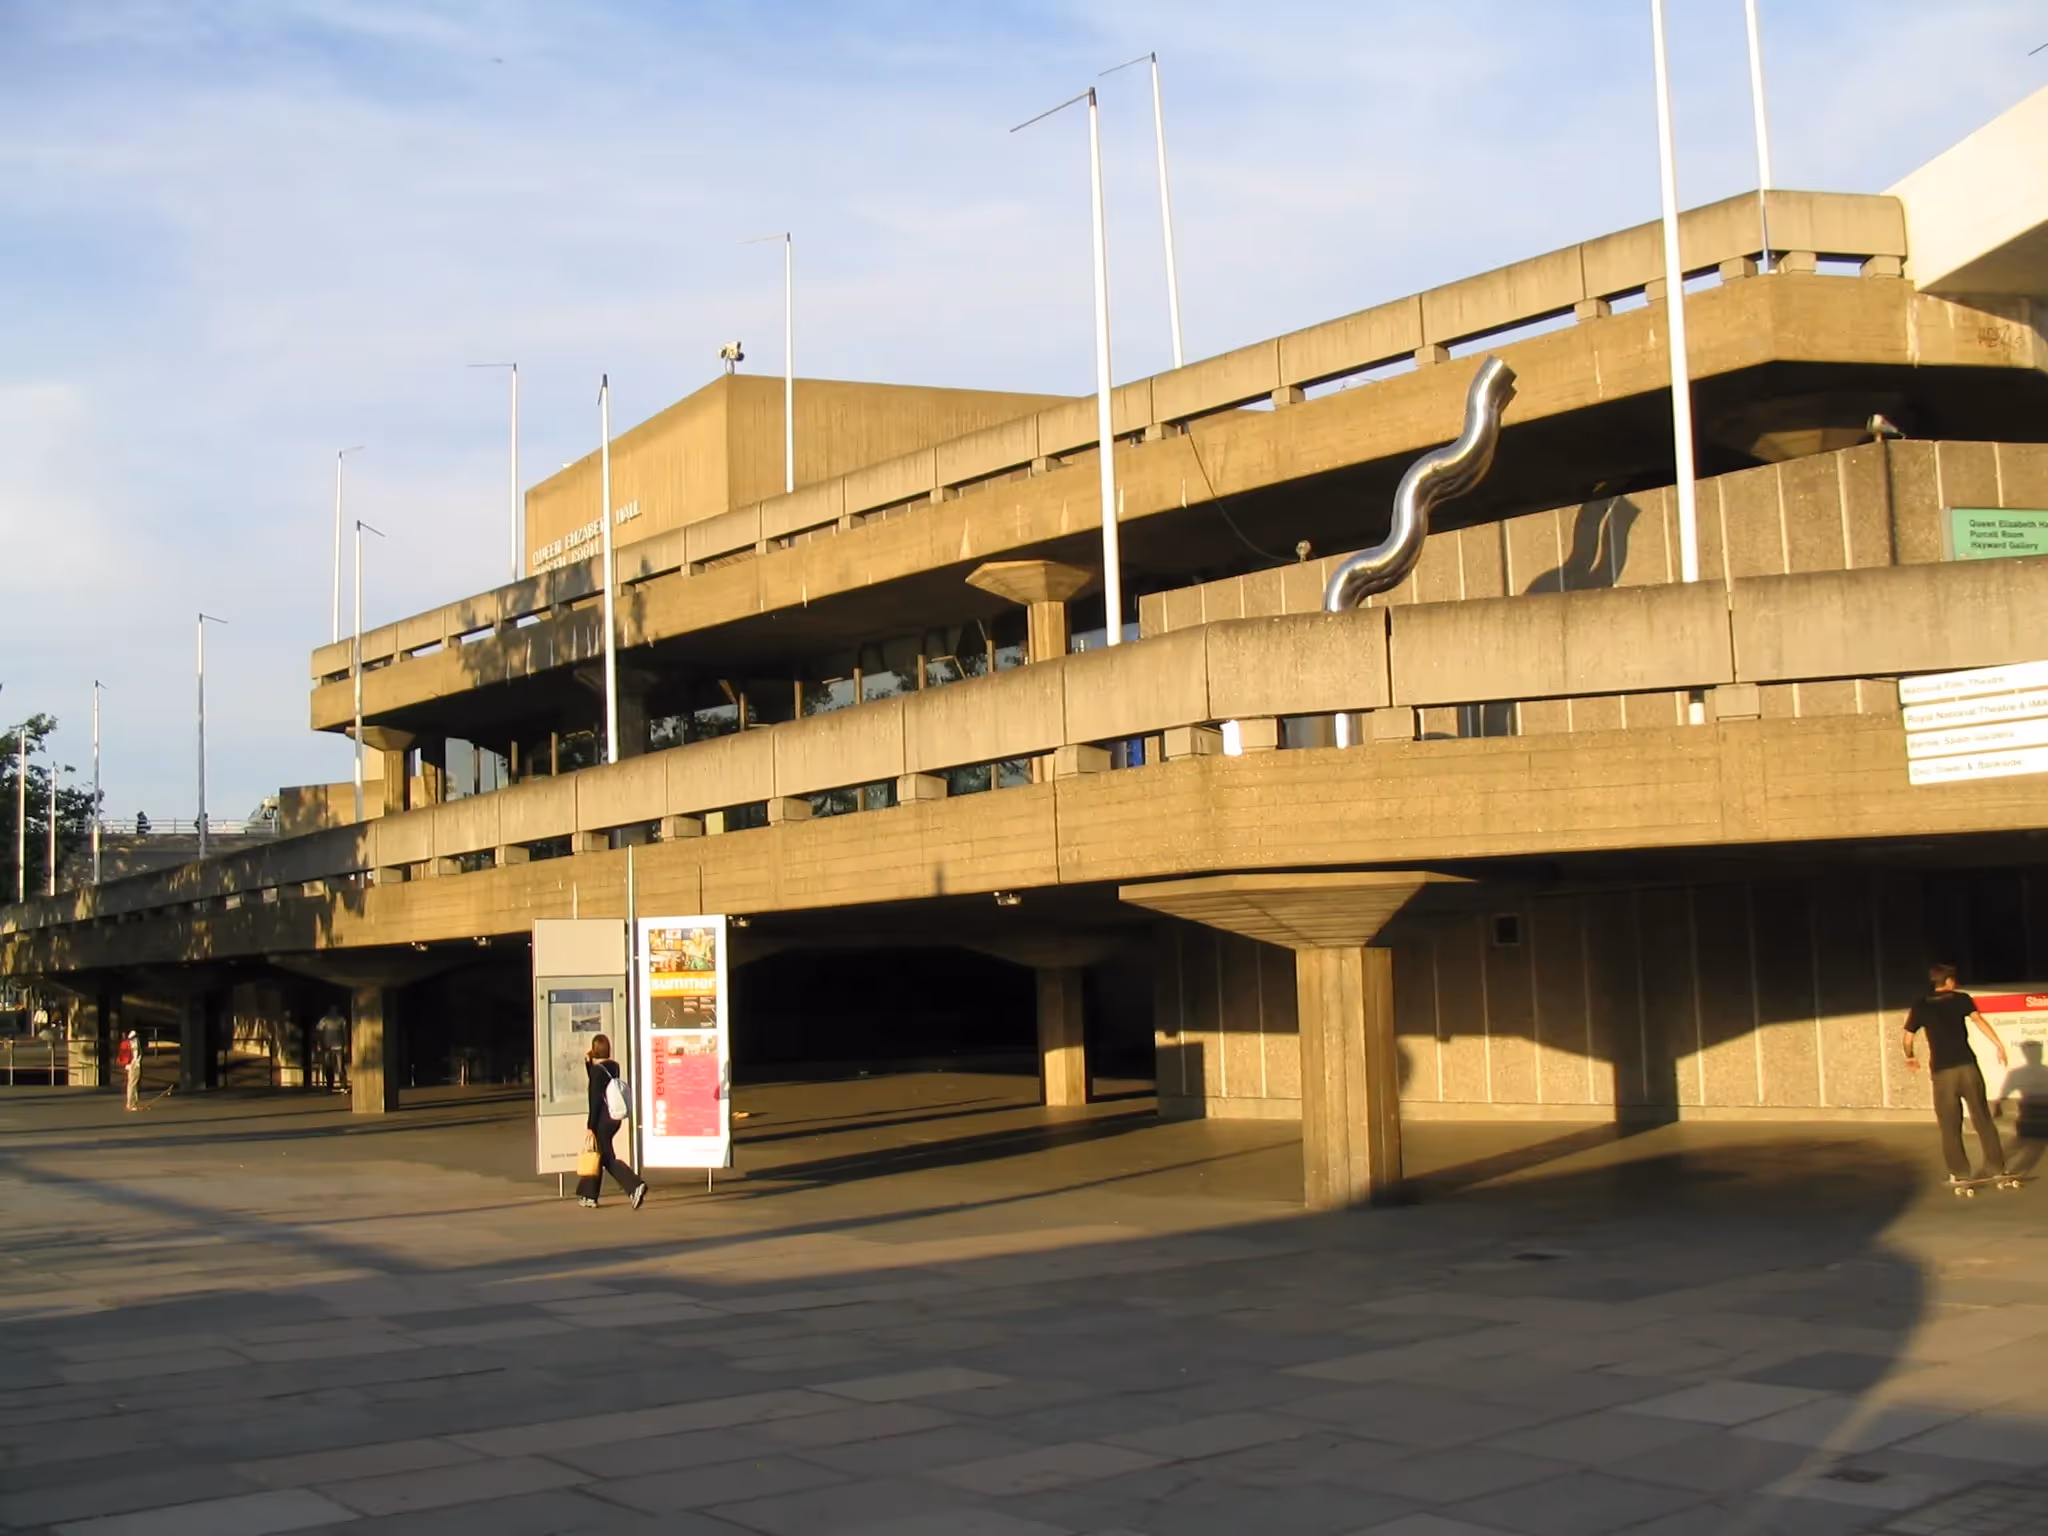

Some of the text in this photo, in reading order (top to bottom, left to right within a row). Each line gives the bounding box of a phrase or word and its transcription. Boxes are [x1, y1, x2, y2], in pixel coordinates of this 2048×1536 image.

[1969, 519, 1996, 528] Queen
[1999, 519, 2037, 528] Elizabeth
[532, 499, 641, 566] QUEEN ELIZABET HALL
[1969, 530, 2024, 538] Purcell Room
[1970, 541, 2039, 551] Hayward Gallery
[1968, 675, 2007, 686] Theatre
[1907, 714, 1934, 724] Royal
[1936, 708, 1976, 719] National
[1979, 704, 2016, 713] Theatre
[2019, 702, 2026, 710] &
[1977, 758, 2022, 769] Bankside
[651, 977, 715, 991] summer
[1993, 1017, 2017, 1026] Queen
[654, 1037, 667, 1135] free events
